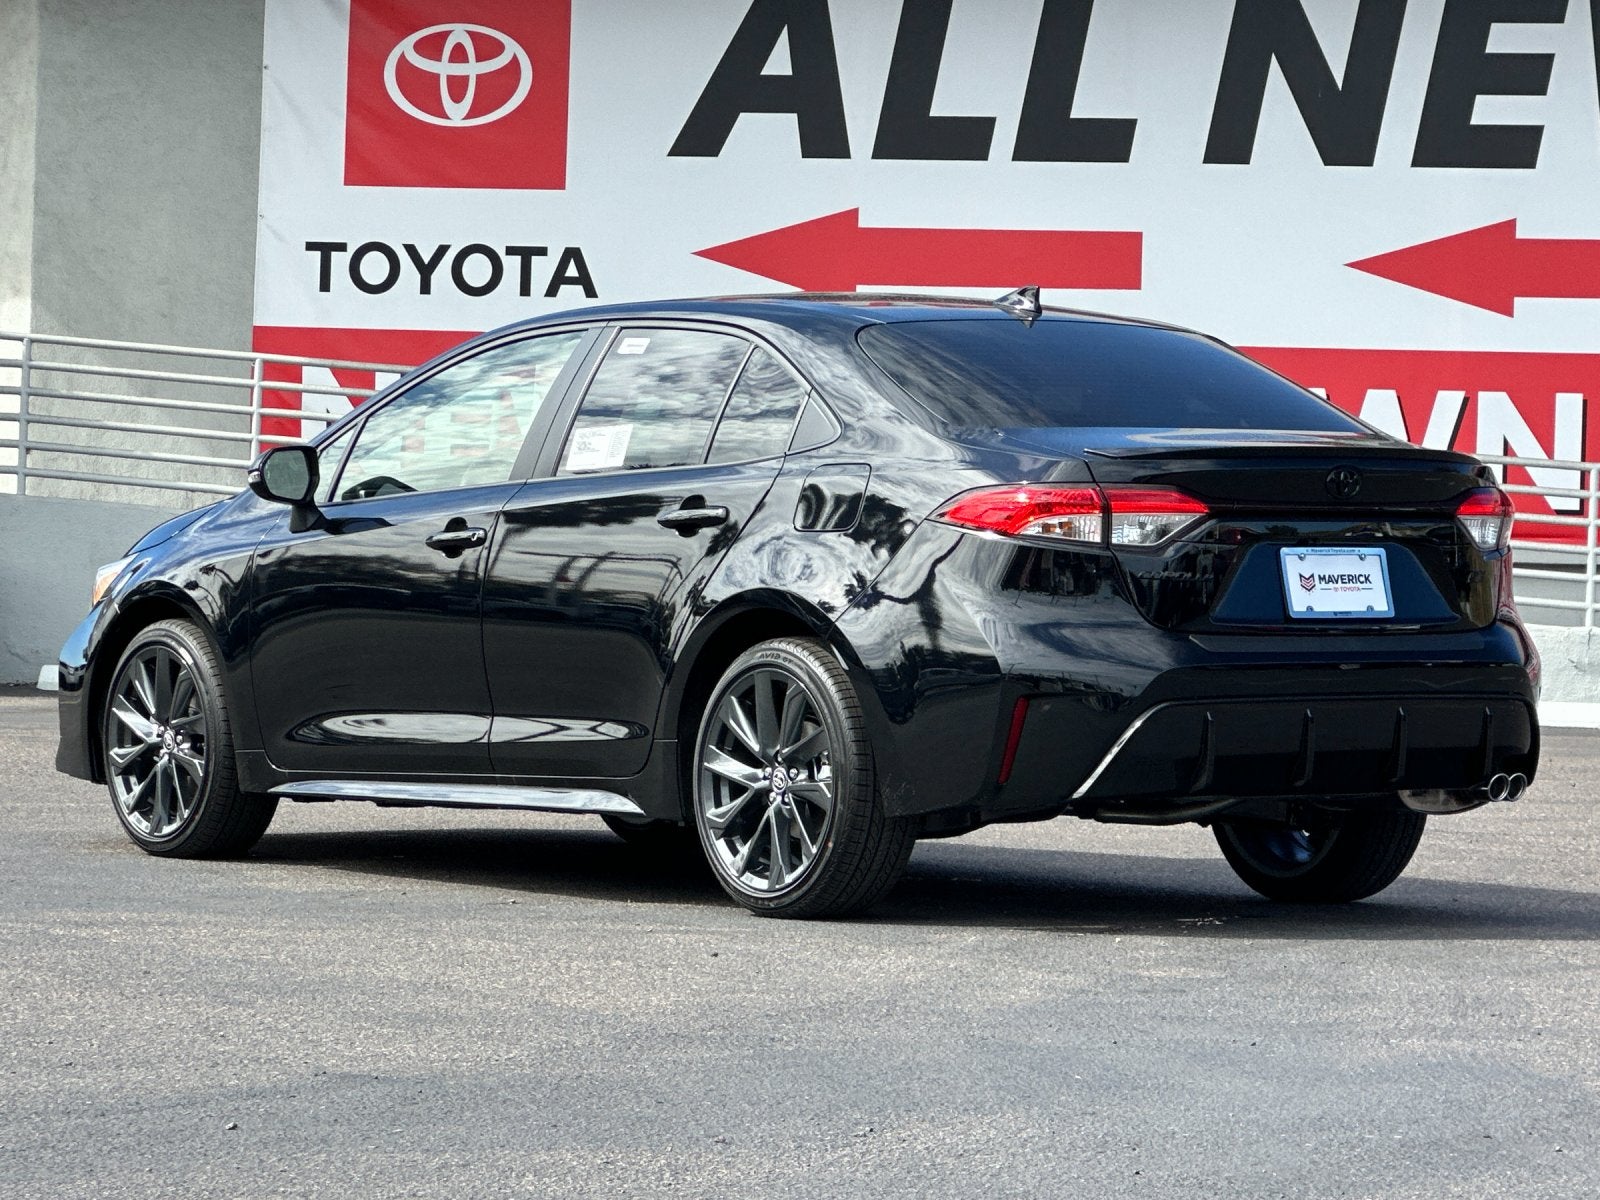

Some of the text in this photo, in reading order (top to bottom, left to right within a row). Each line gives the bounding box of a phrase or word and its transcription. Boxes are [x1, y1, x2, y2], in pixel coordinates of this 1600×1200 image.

[666, 0, 1600, 169] ALL NE
[305, 241, 599, 299] TOYOTA
[1318, 574, 1372, 584] MAVERICK
